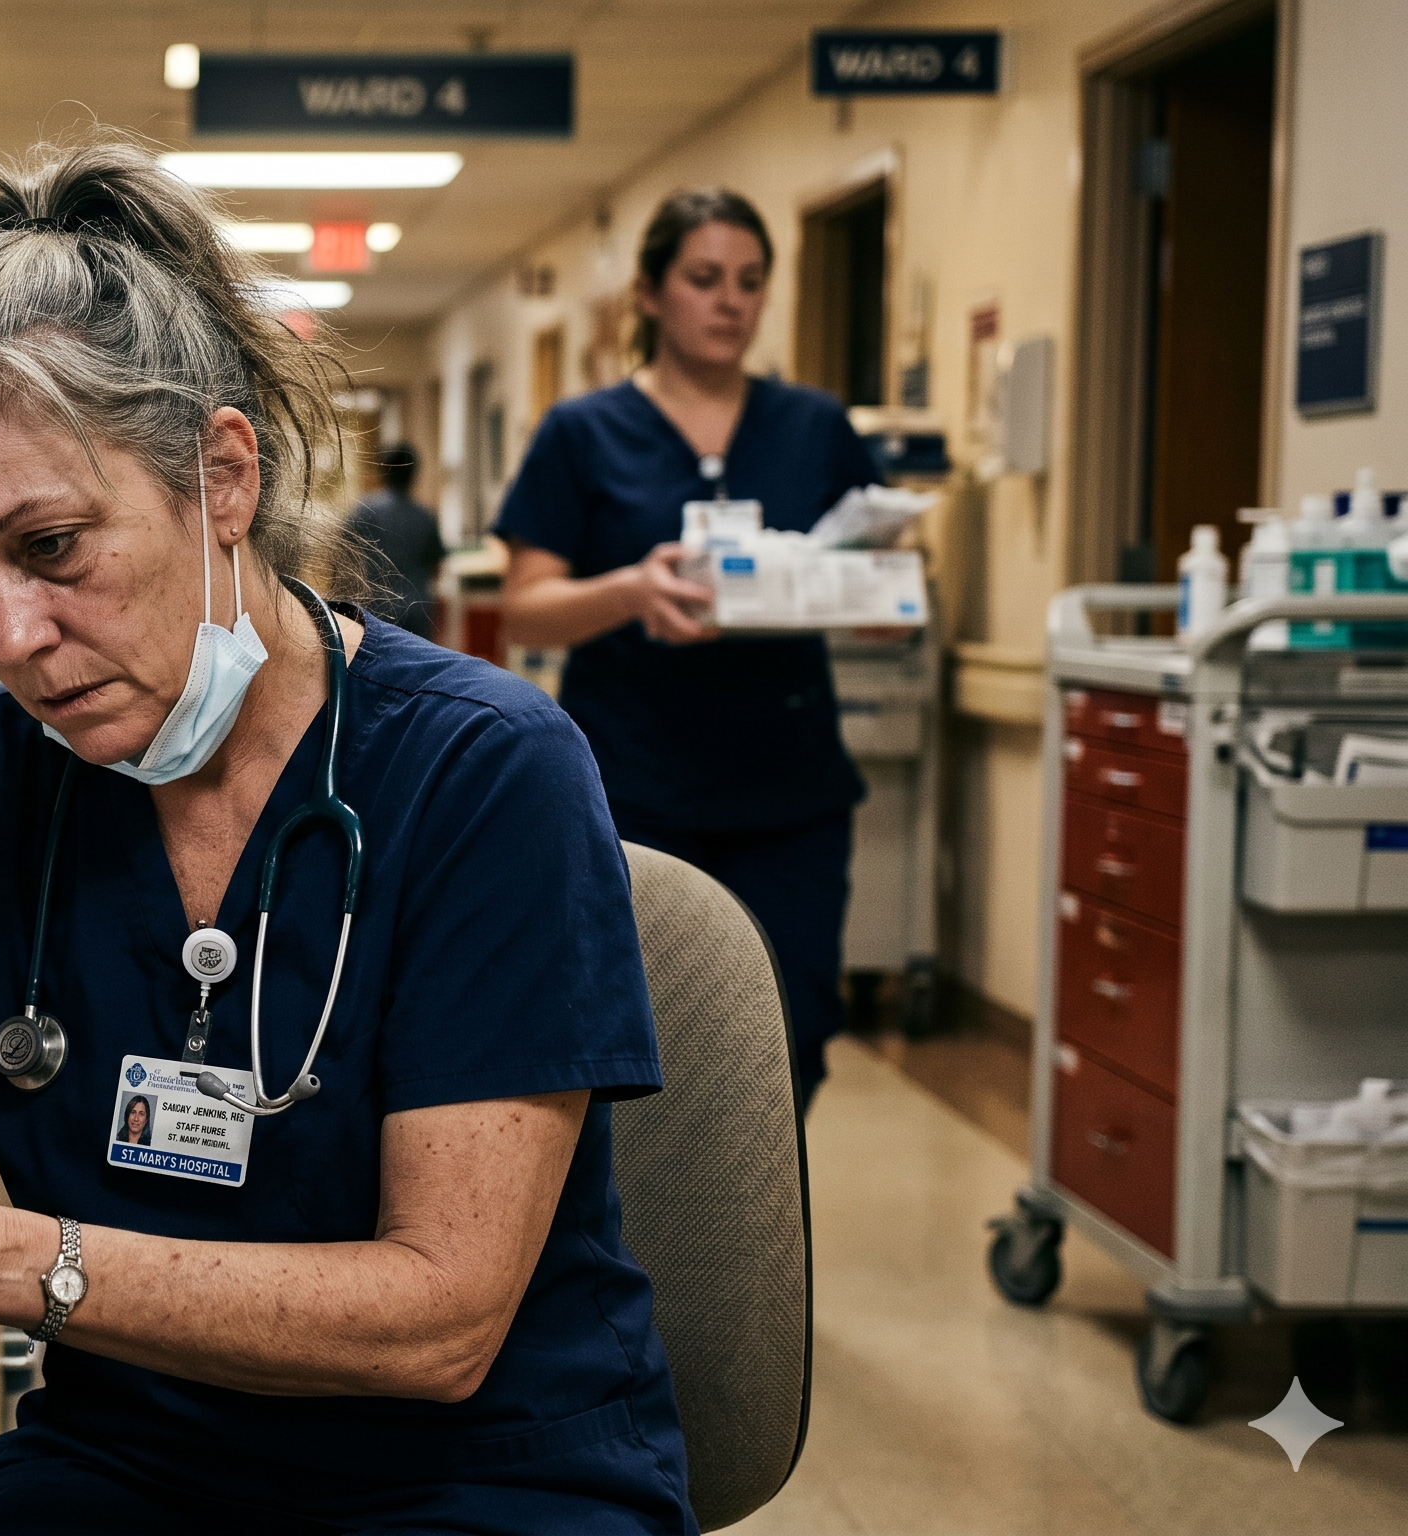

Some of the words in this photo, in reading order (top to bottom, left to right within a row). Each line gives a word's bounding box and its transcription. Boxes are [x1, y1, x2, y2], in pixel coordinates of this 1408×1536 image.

[828, 44, 944, 83] WARD
[951, 44, 982, 83] 4
[297, 75, 428, 117] WARD
[435, 75, 468, 117] 4
[193, 1106, 228, 1121] JENKINS,
[167, 1132, 178, 1142] ST.
[175, 1121, 200, 1133] STAFF
[121, 1148, 136, 1162] ST.
[138, 1151, 177, 1168] MARY'S
[179, 1158, 230, 1178] HOSPITAL
